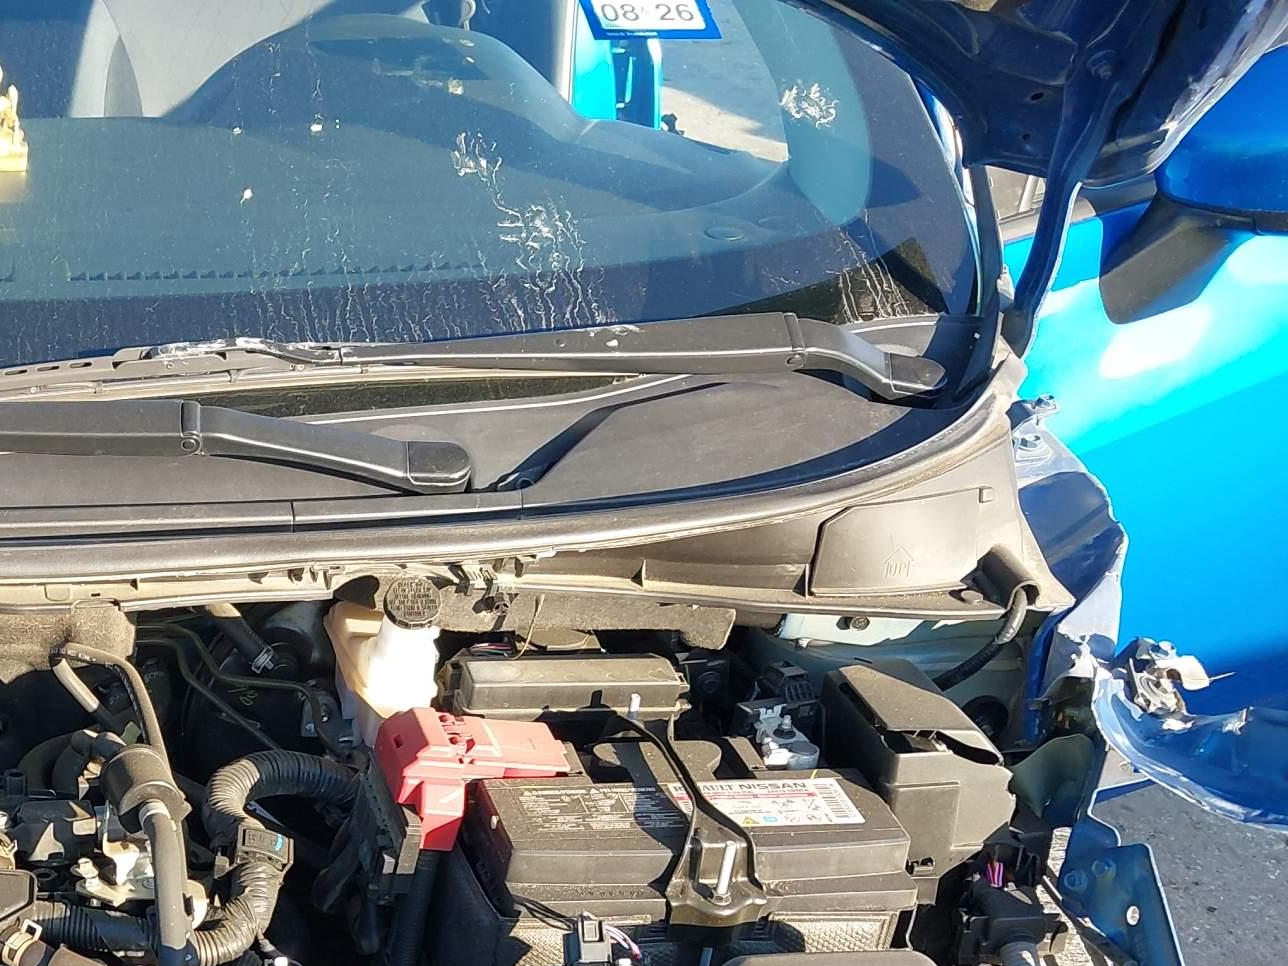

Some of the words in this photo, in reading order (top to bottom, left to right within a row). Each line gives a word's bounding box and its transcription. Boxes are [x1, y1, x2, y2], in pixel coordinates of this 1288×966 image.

[601, 3, 640, 21] 08
[655, 3, 694, 21] 26
[738, 782, 807, 790] NISSAN
